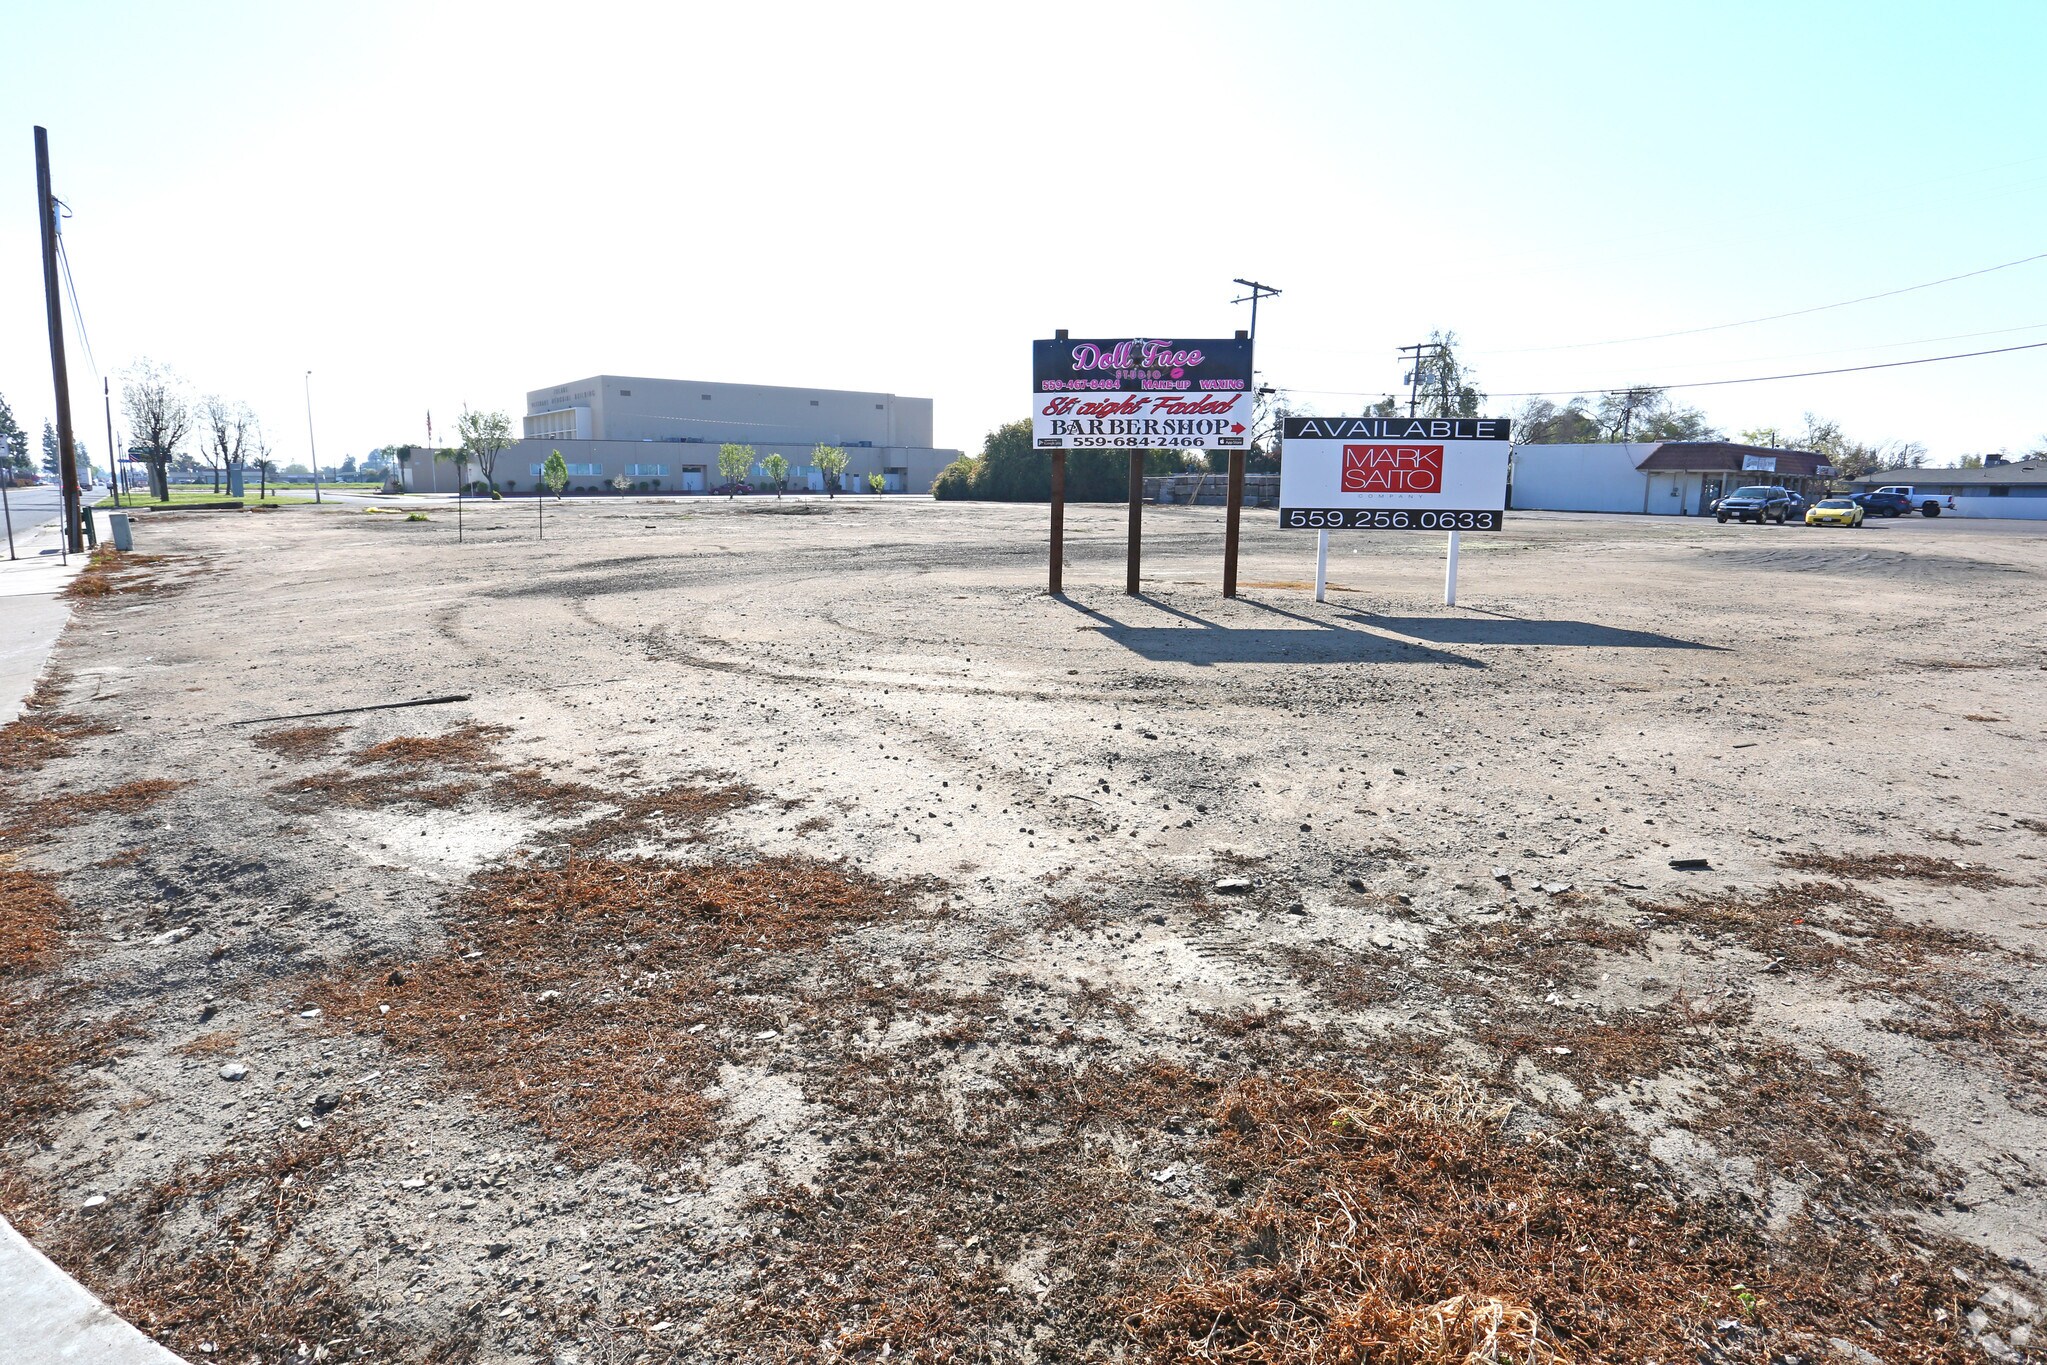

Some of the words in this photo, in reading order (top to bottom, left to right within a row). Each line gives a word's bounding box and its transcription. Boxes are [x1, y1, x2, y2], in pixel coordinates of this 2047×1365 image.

[1072, 341, 1132, 371] Doll
[1141, 340, 1205, 367] Face
[1115, 370, 1161, 379] STUDIO
[1141, 379, 1191, 390] MAKE-UP
[1199, 379, 1245, 390] WAXING
[1151, 393, 1243, 416] Faded
[1050, 418, 1230, 436] BARBERSHOP
[1298, 420, 1497, 438] AVAILABLE
[1073, 437, 1205, 447] 559-684-2466
[1345, 448, 1439, 469] MARK
[1345, 469, 1435, 490] SAITO
[1290, 510, 1493, 529] 559.256.0633
